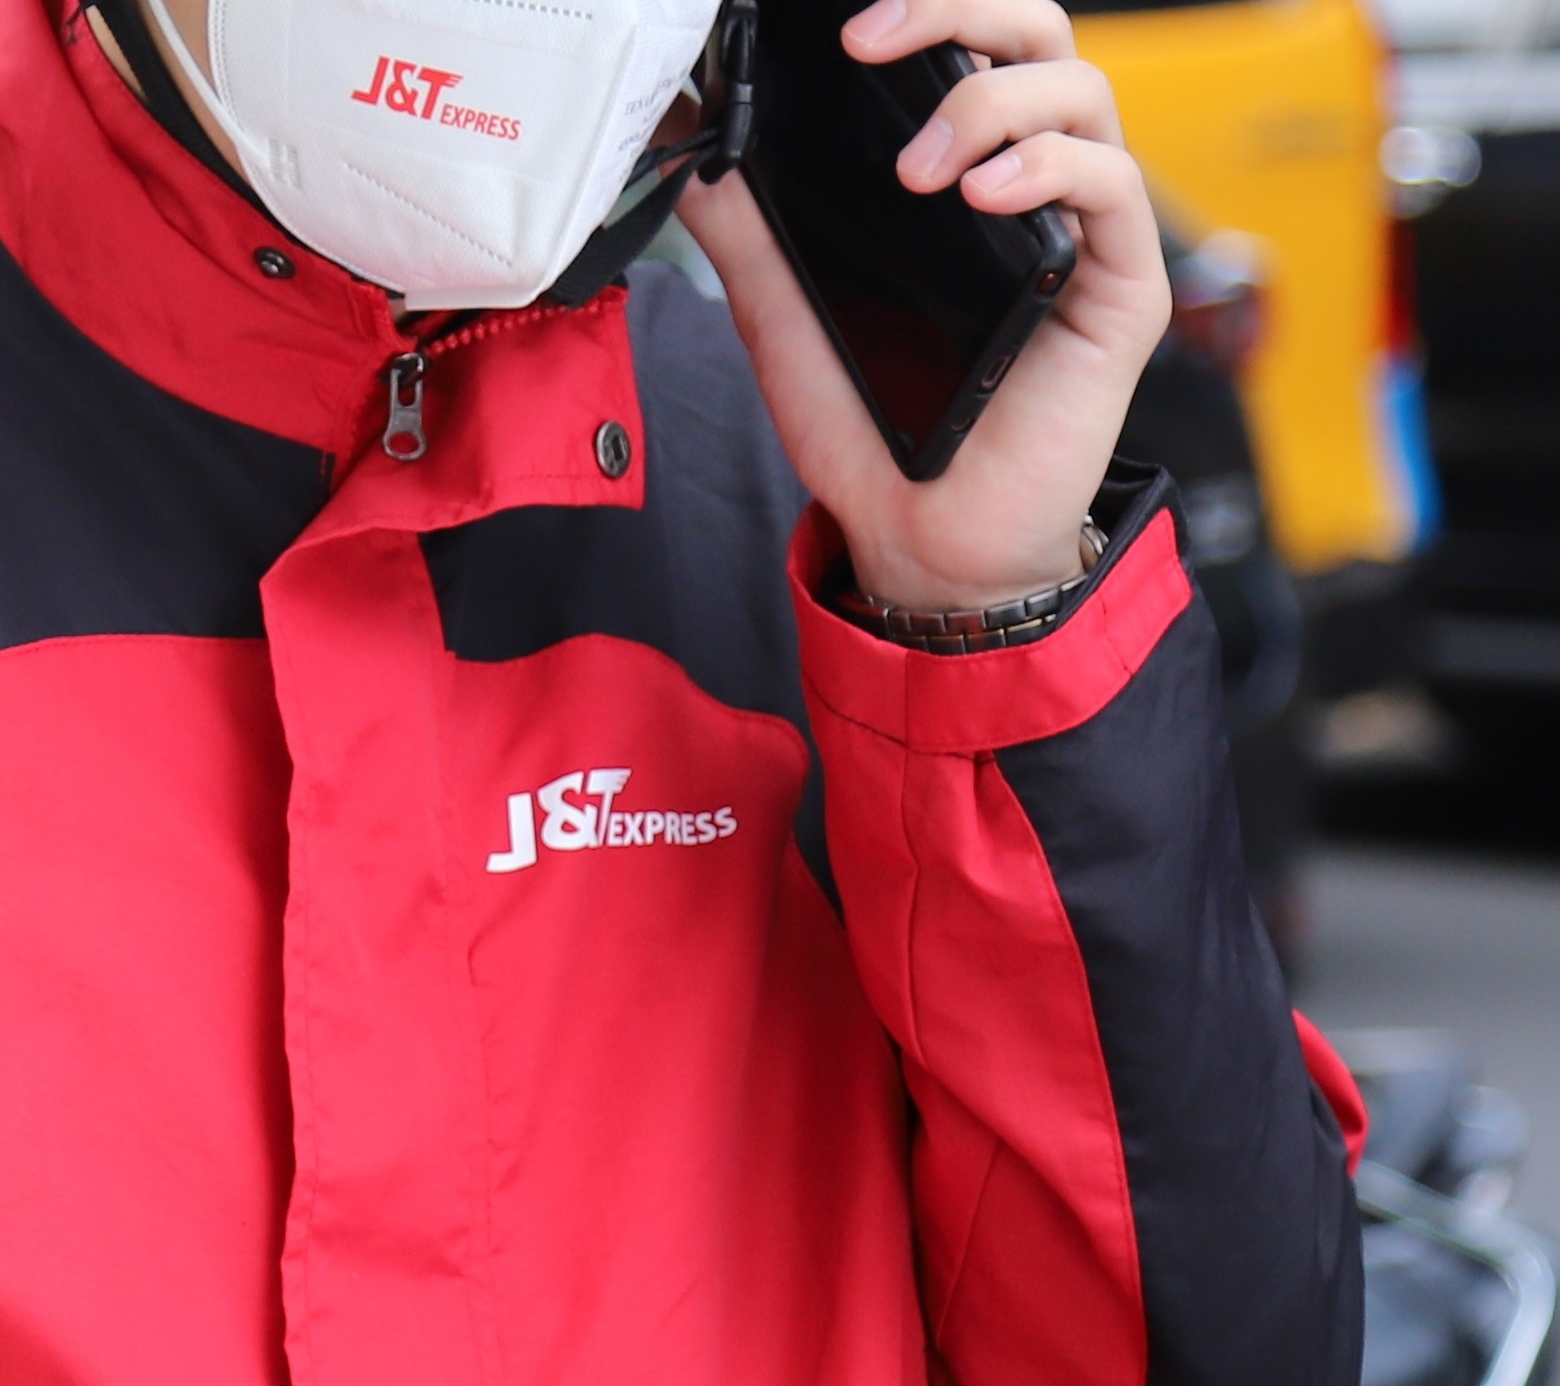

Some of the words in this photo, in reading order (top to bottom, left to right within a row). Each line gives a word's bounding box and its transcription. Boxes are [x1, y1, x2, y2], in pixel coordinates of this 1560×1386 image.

[351, 54, 464, 121] J&T
[439, 102, 522, 142] EXPRESS
[485, 766, 632, 874] J&T
[606, 805, 738, 847] EXPRESS
